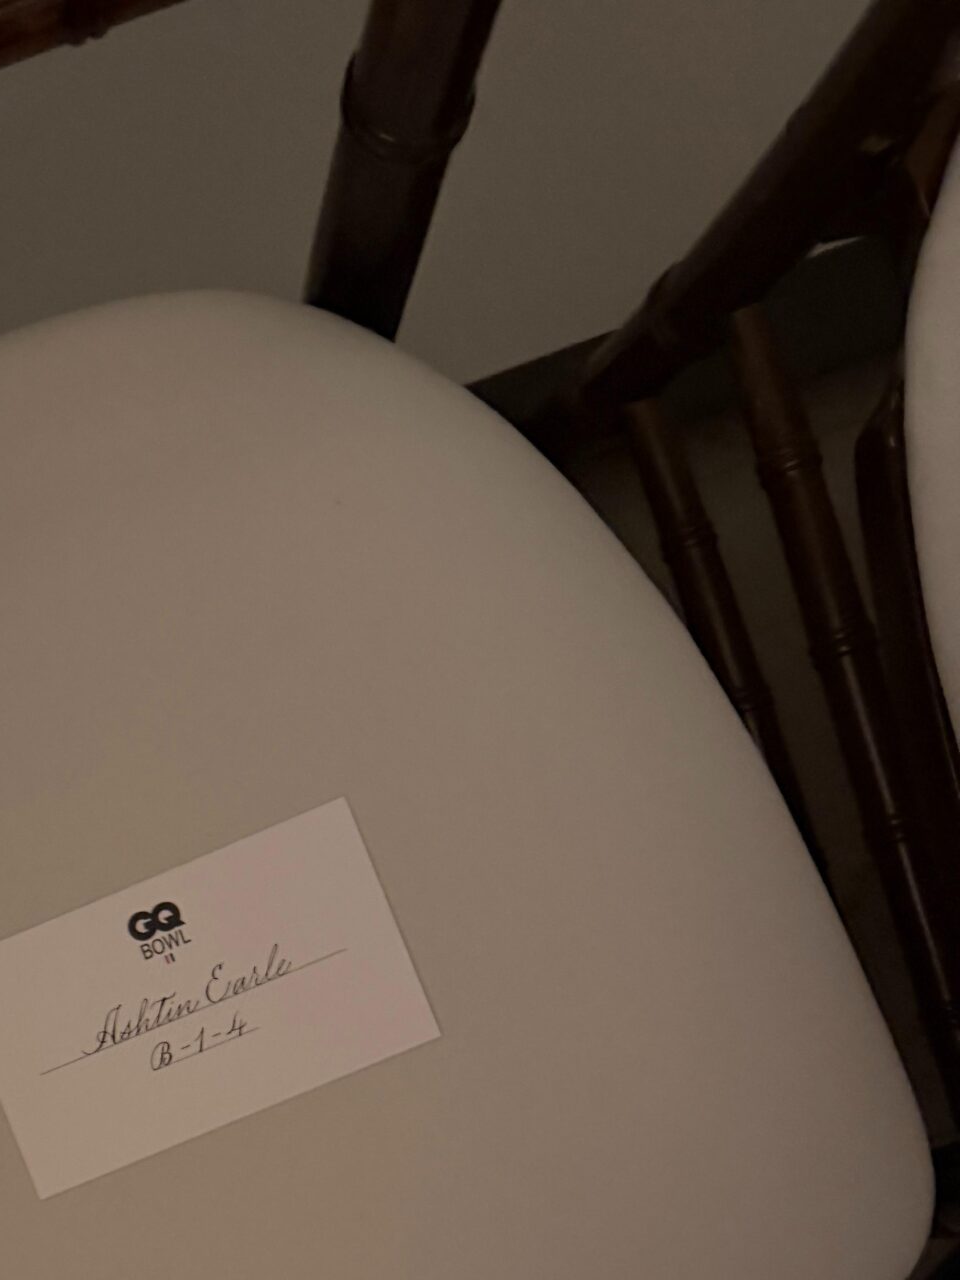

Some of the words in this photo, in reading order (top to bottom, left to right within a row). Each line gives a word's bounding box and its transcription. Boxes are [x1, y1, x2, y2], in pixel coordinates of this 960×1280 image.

[128, 901, 186, 941] GQ
[140, 929, 192, 960] BOWL
[82, 993, 200, 1056] Ashtin
[205, 944, 293, 1004] Earle
[150, 1011, 248, 1071] B-1-4
